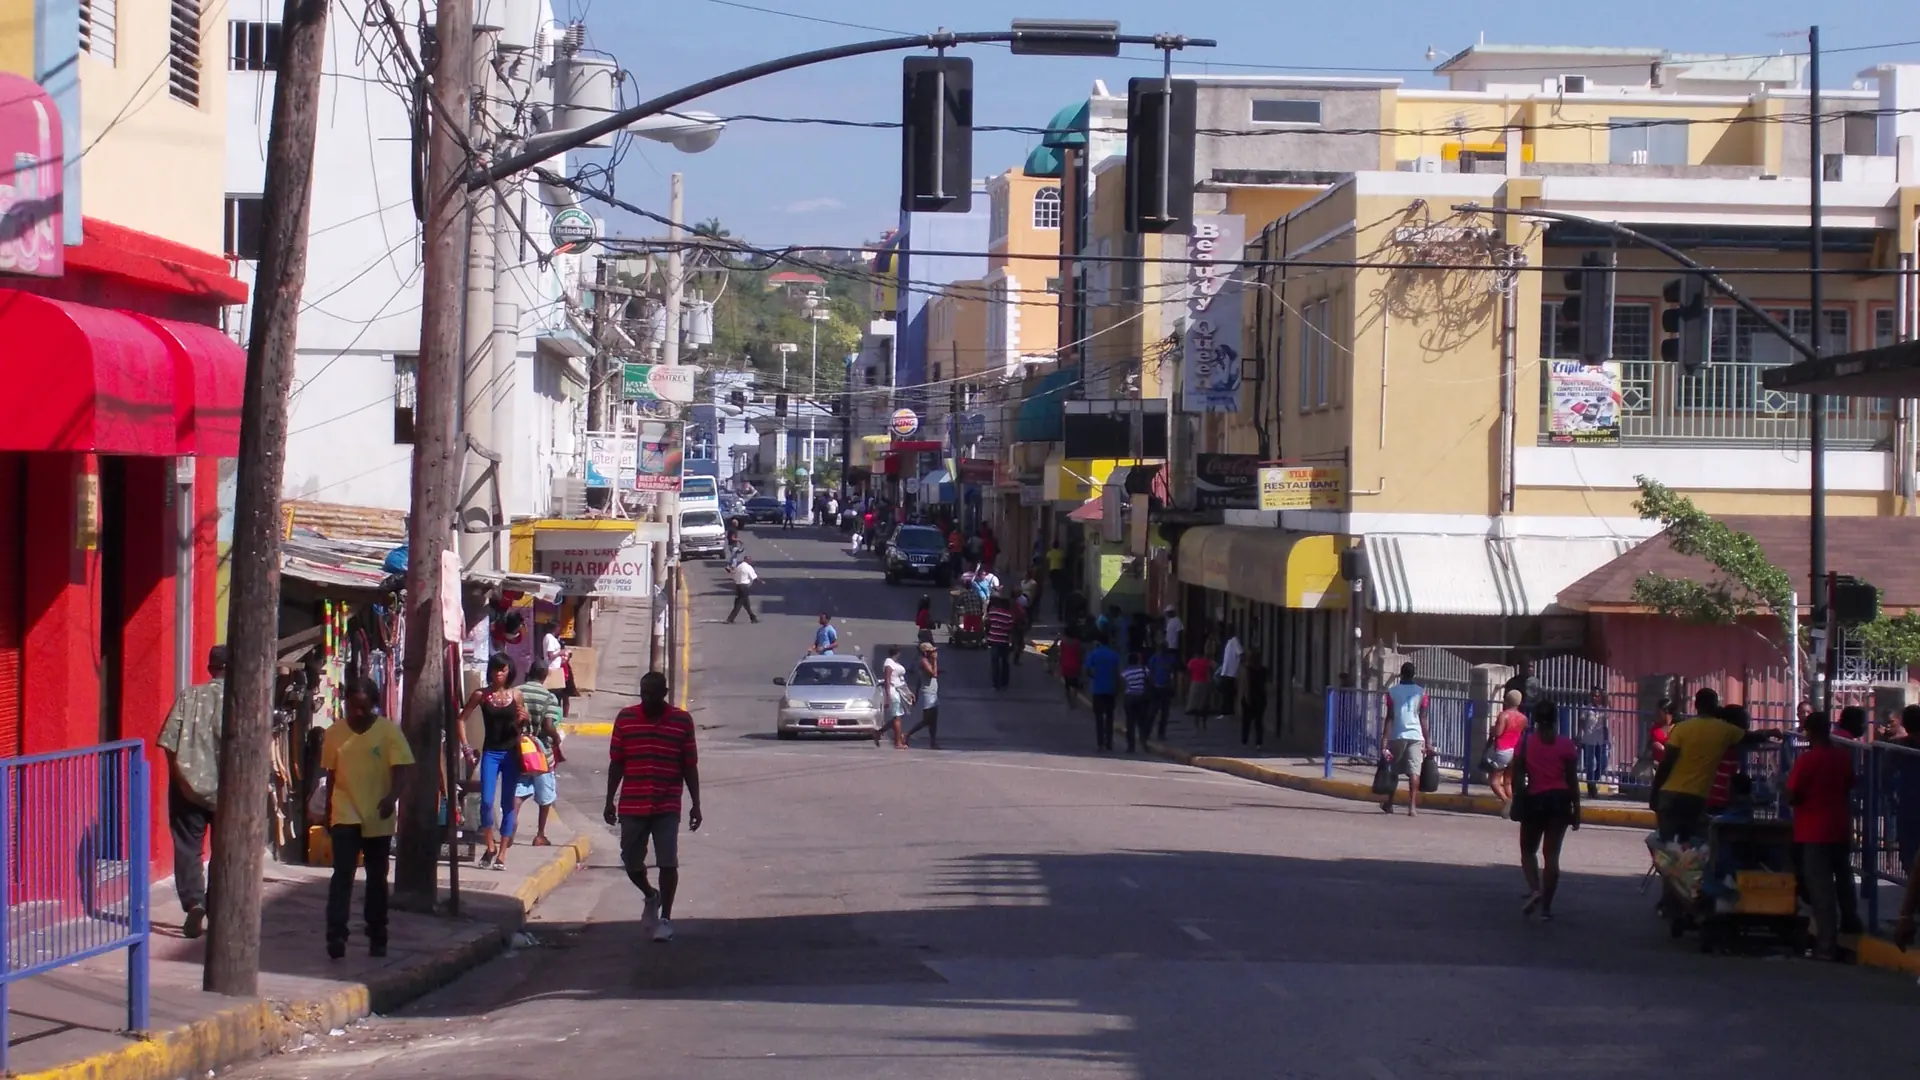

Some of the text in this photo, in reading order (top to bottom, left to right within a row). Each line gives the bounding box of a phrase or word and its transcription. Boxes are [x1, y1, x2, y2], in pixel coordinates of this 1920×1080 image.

[1193, 222, 1220, 311] Beauty
[592, 450, 632, 465] Interet
[1264, 480, 1339, 490] RESTAURANT
[551, 561, 643, 576] PHARMACY
